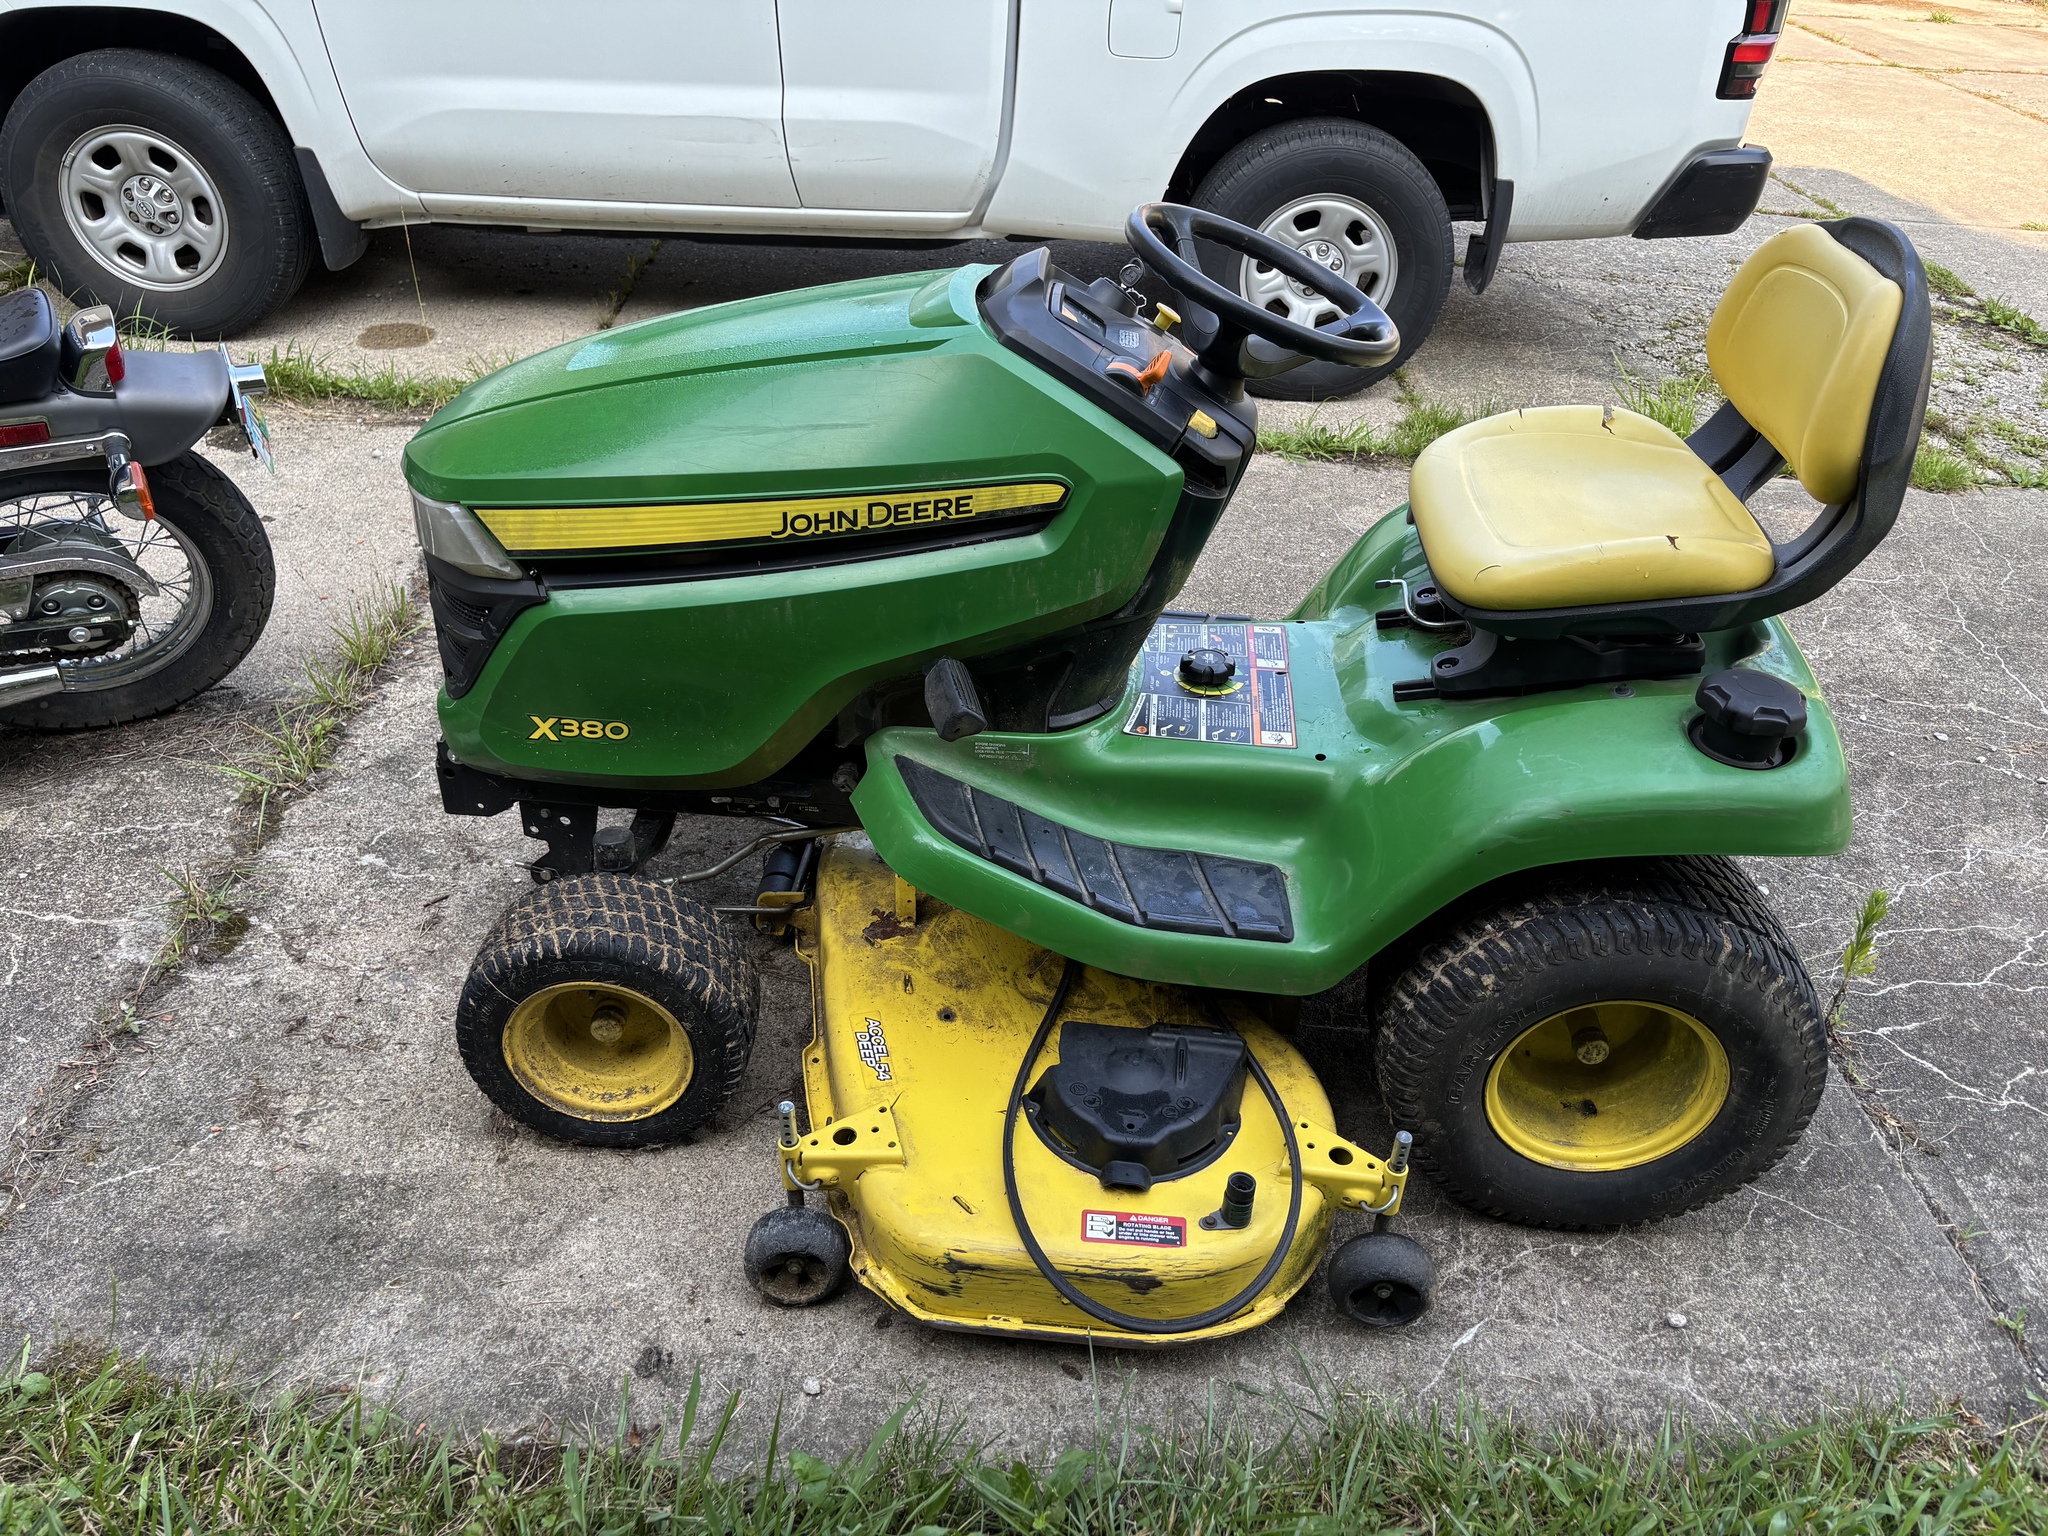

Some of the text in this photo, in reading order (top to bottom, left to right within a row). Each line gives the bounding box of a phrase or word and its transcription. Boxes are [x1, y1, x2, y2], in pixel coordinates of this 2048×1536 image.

[771, 495, 974, 536] JOHN DEERE
[526, 715, 631, 742] X380
[855, 1032, 877, 1068] DEEP
[865, 1017, 892, 1081] ACCEL 54
[1137, 1215, 1169, 1223] DANGER
